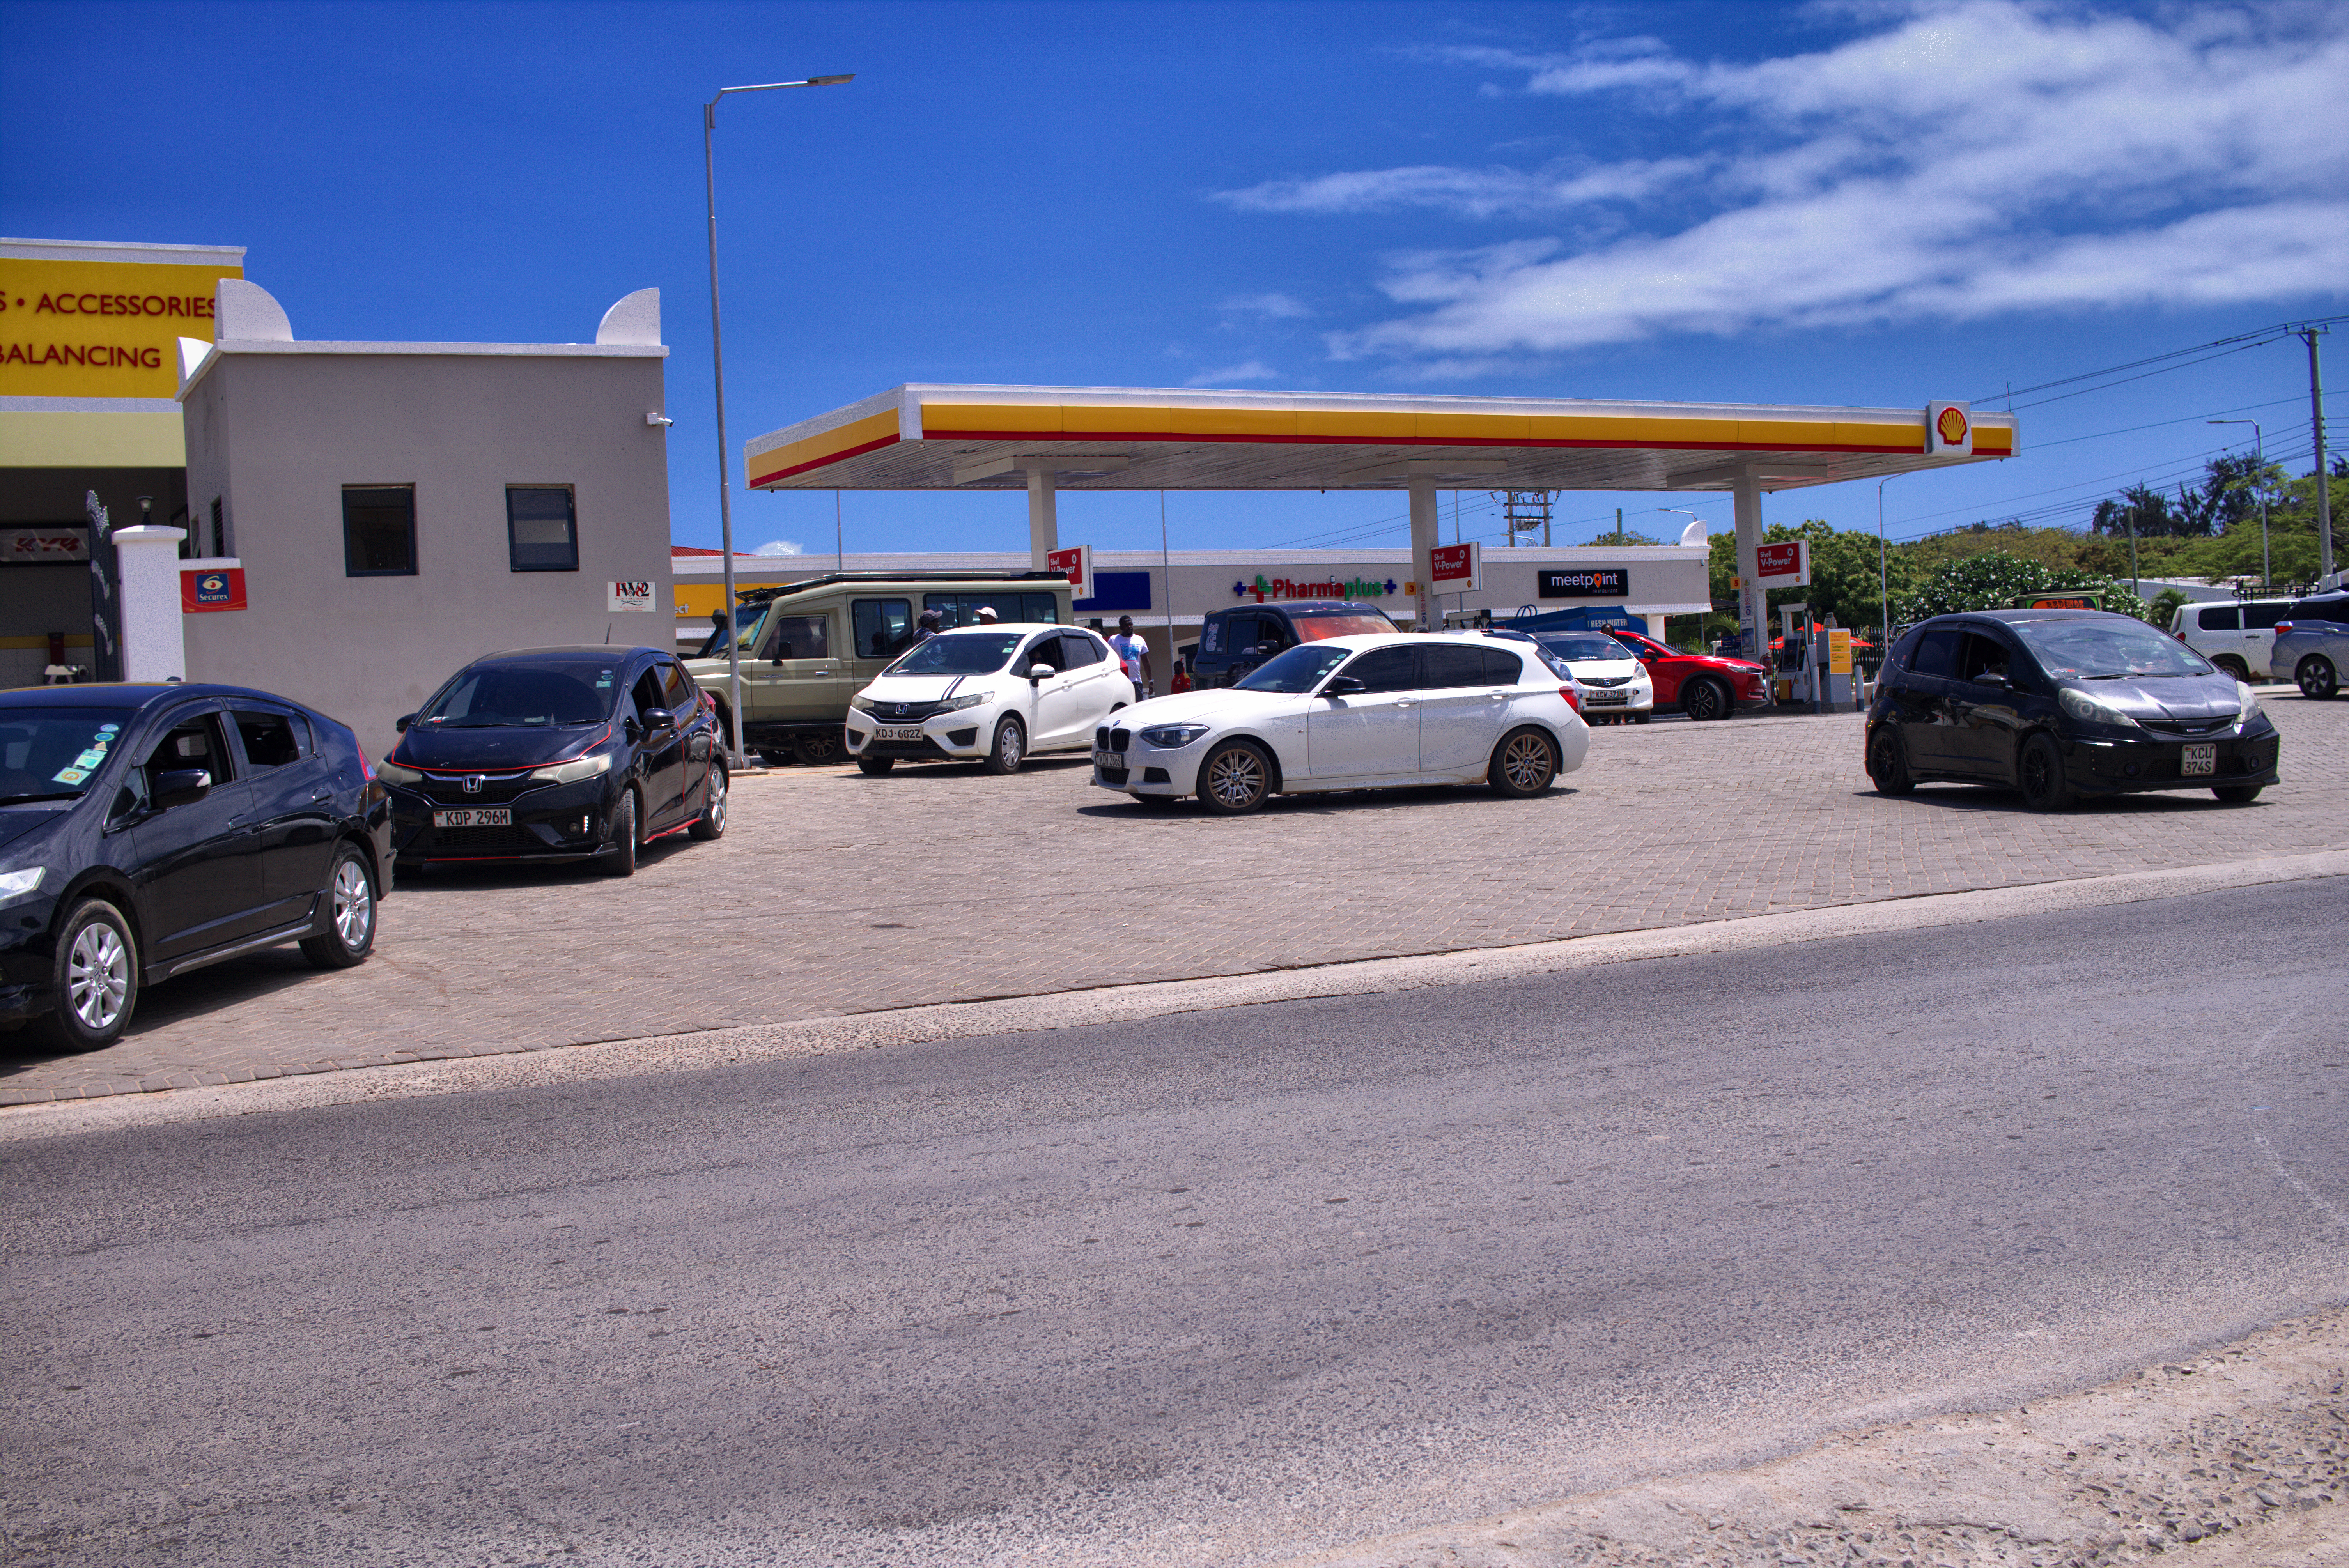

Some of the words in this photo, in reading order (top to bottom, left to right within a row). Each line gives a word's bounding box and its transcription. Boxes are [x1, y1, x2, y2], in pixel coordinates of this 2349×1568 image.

[36, 293, 214, 318] ACCESSORIES
[16, 538, 80, 552] KYB
[1050, 557, 1059, 566] Shell
[1434, 552, 1445, 561] Shell
[1760, 557, 1791, 567] V-Power
[1434, 561, 1463, 571] V-Power
[1273, 578, 1383, 601] Pharmaplus
[876, 728, 893, 738] KDJ
[897, 729, 921, 738] 682Z
[2191, 747, 2211, 759] KCU
[1110, 754, 1121, 767] 286S
[2184, 761, 2211, 773] 374S
[446, 811, 471, 825] KDP
[476, 810, 508, 825] 296M
